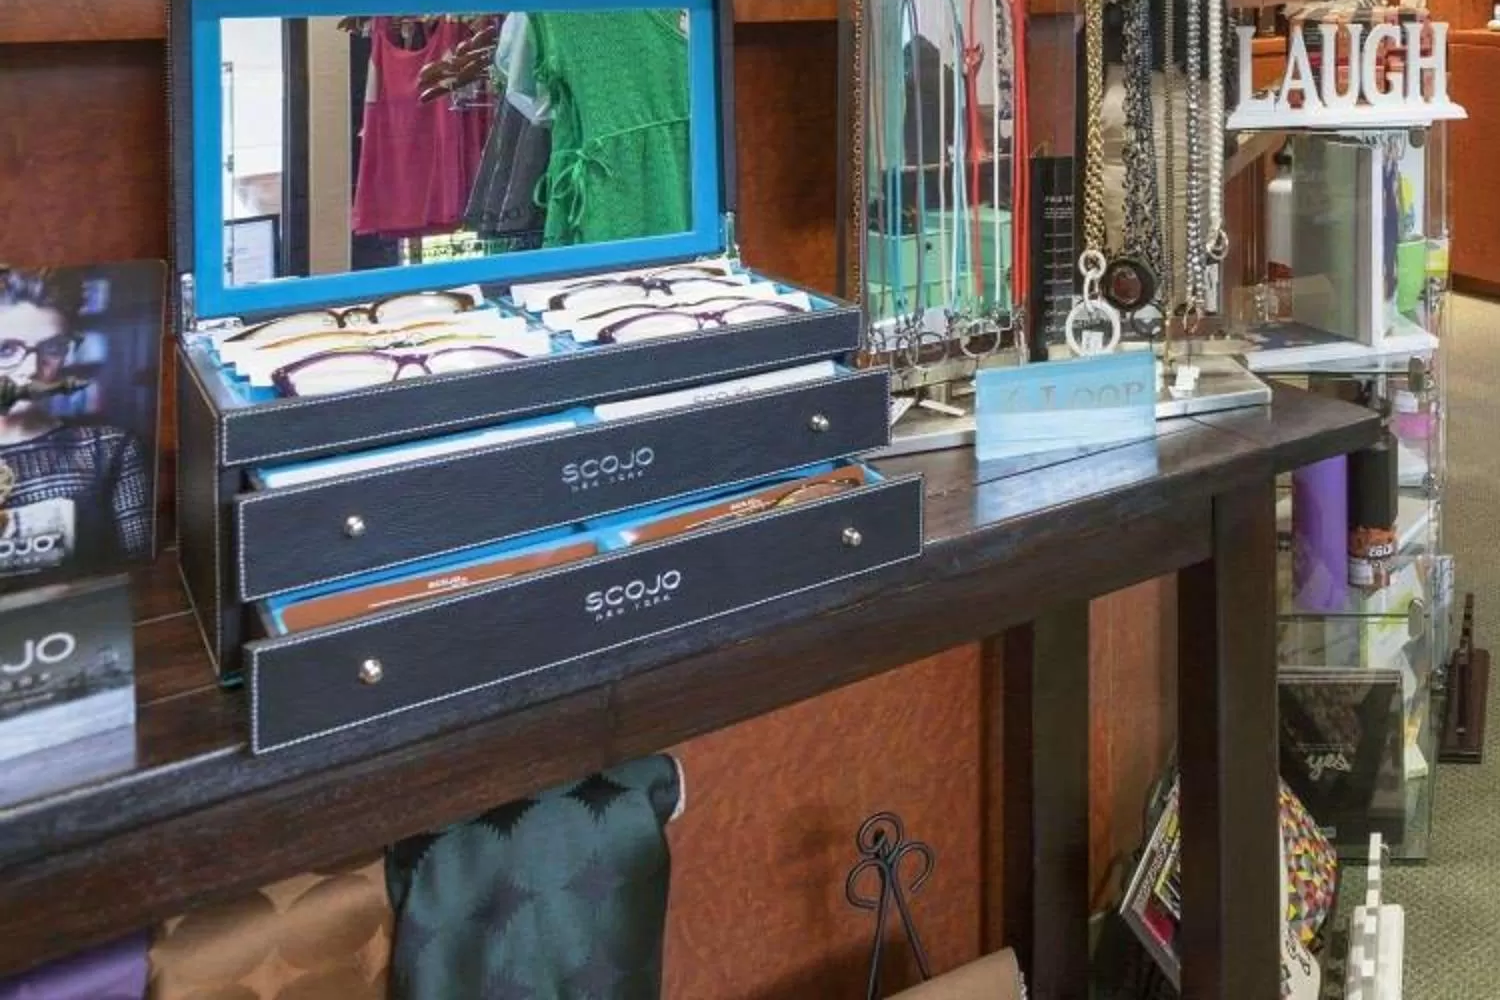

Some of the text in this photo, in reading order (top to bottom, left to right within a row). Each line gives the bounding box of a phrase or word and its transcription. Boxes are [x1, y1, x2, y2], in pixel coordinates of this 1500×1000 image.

[1235, 21, 1450, 109] LAUGH
[561, 446, 655, 483] SCOJO
[585, 569, 681, 612] SCOJO
